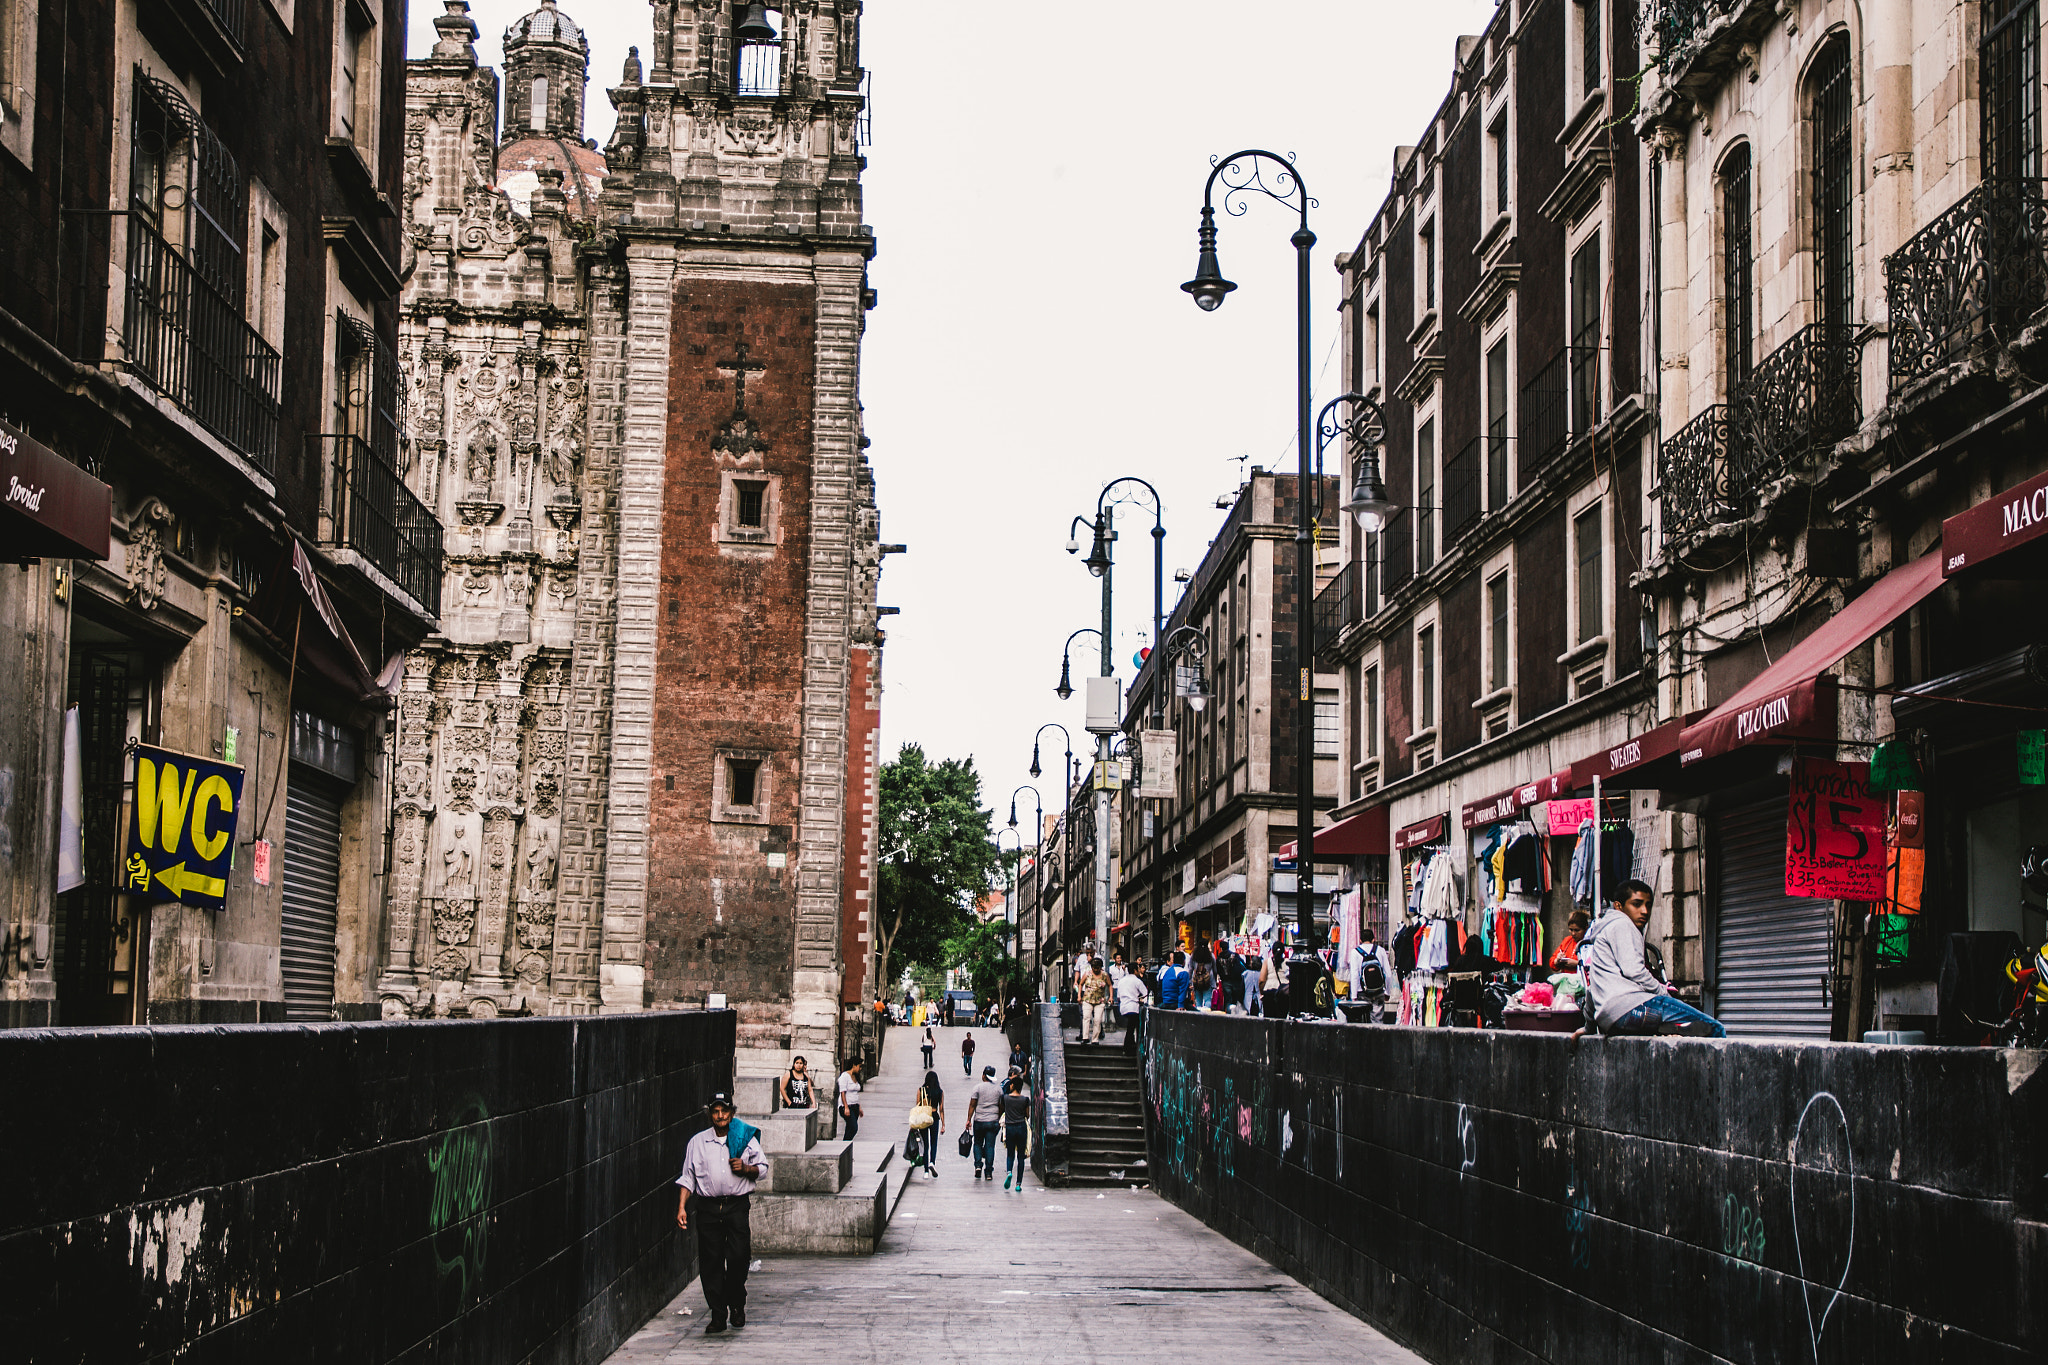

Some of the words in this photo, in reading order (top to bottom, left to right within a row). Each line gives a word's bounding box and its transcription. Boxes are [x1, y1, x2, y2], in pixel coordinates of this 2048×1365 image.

[6, 475, 45, 512] Jovial
[1948, 553, 1965, 570] JEANS
[1738, 695, 1789, 739] PELUCHIN
[1610, 740, 1641, 770] SWEATERS
[138, 757, 233, 861] WC
